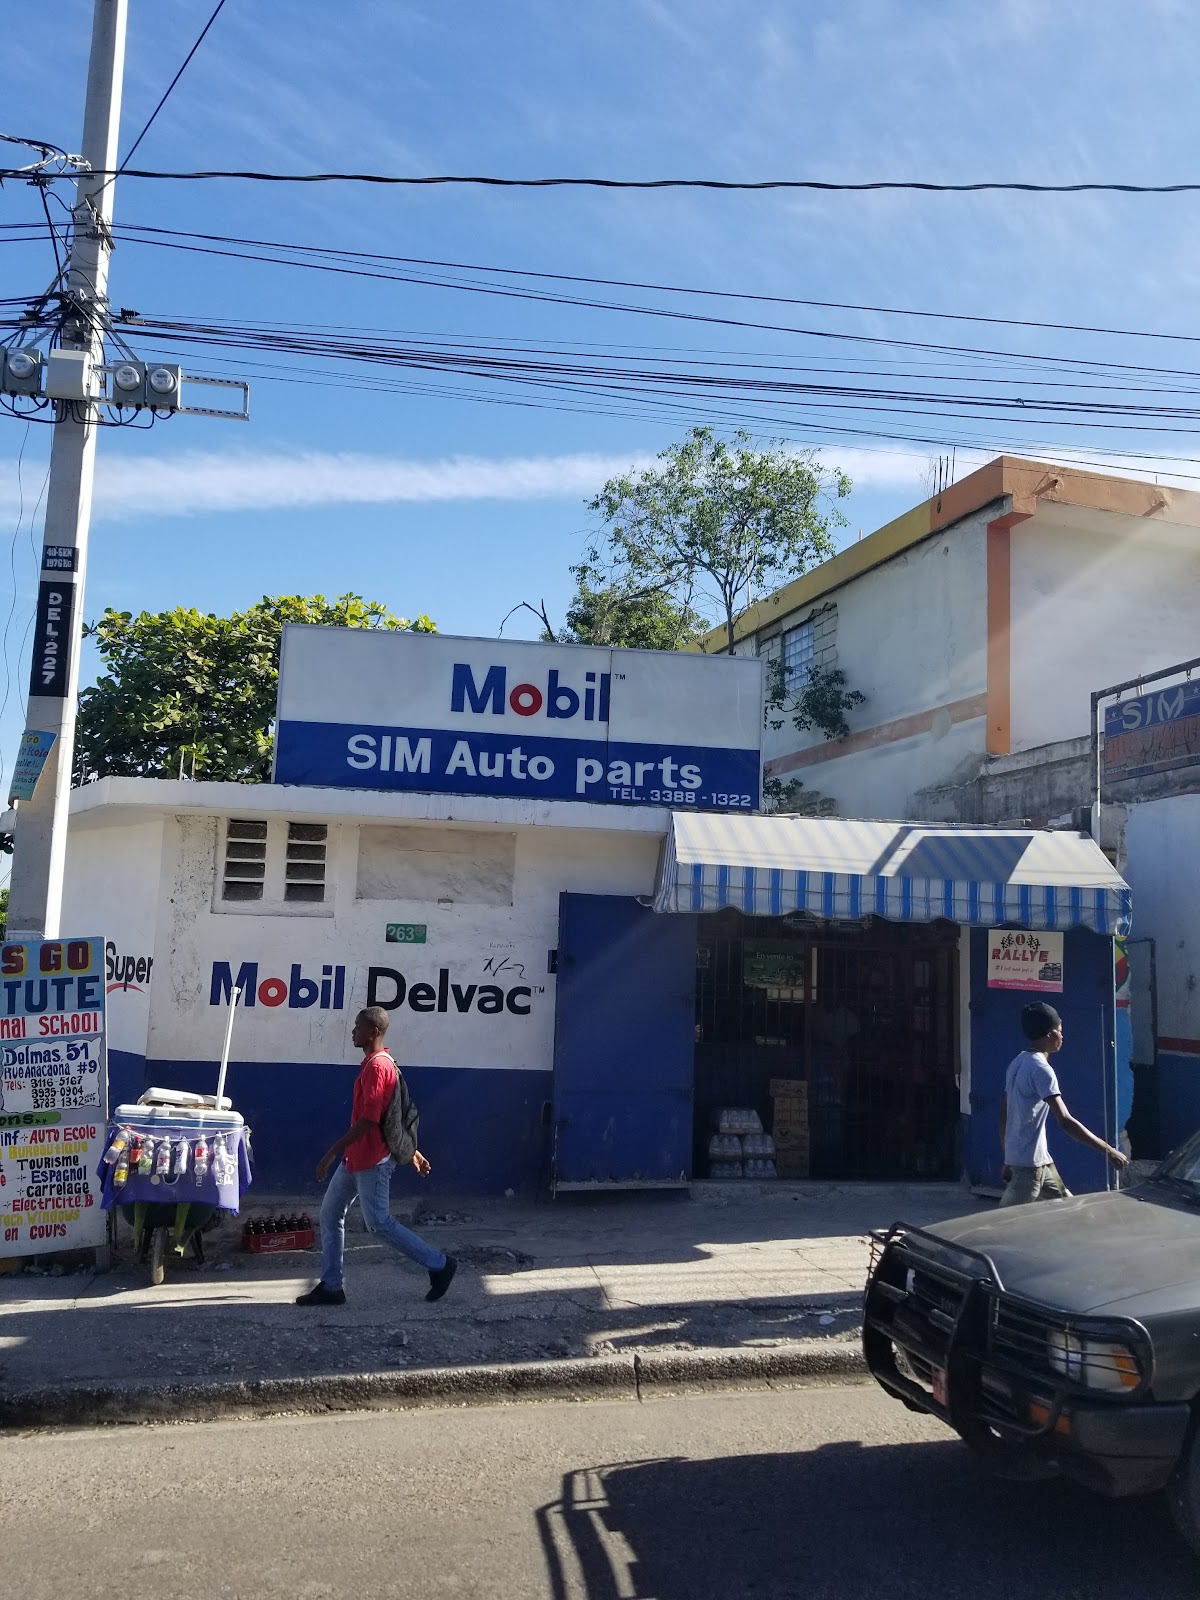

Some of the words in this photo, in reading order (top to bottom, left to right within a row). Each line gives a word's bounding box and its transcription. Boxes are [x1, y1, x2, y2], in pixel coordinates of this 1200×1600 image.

[451, 663, 611, 721] Mobil
[1122, 688, 1185, 729] SIM
[346, 734, 432, 774] SIM
[445, 740, 555, 781] Auto
[575, 756, 703, 794] parts
[610, 787, 645, 800] TEL.
[650, 790, 696, 803] 3388
[712, 793, 751, 806] 1322
[40, 941, 90, 973] GO
[105, 941, 153, 992] Super
[992, 949, 1049, 962] RALLYE
[4, 975, 100, 1014] TUTE
[210, 961, 346, 1009] Mobil
[366, 966, 532, 1015] Delvac
[66, 1042, 89, 1061] 51
[29, 1129, 60, 1144] AUTO
[4, 1227, 19, 1241] en
